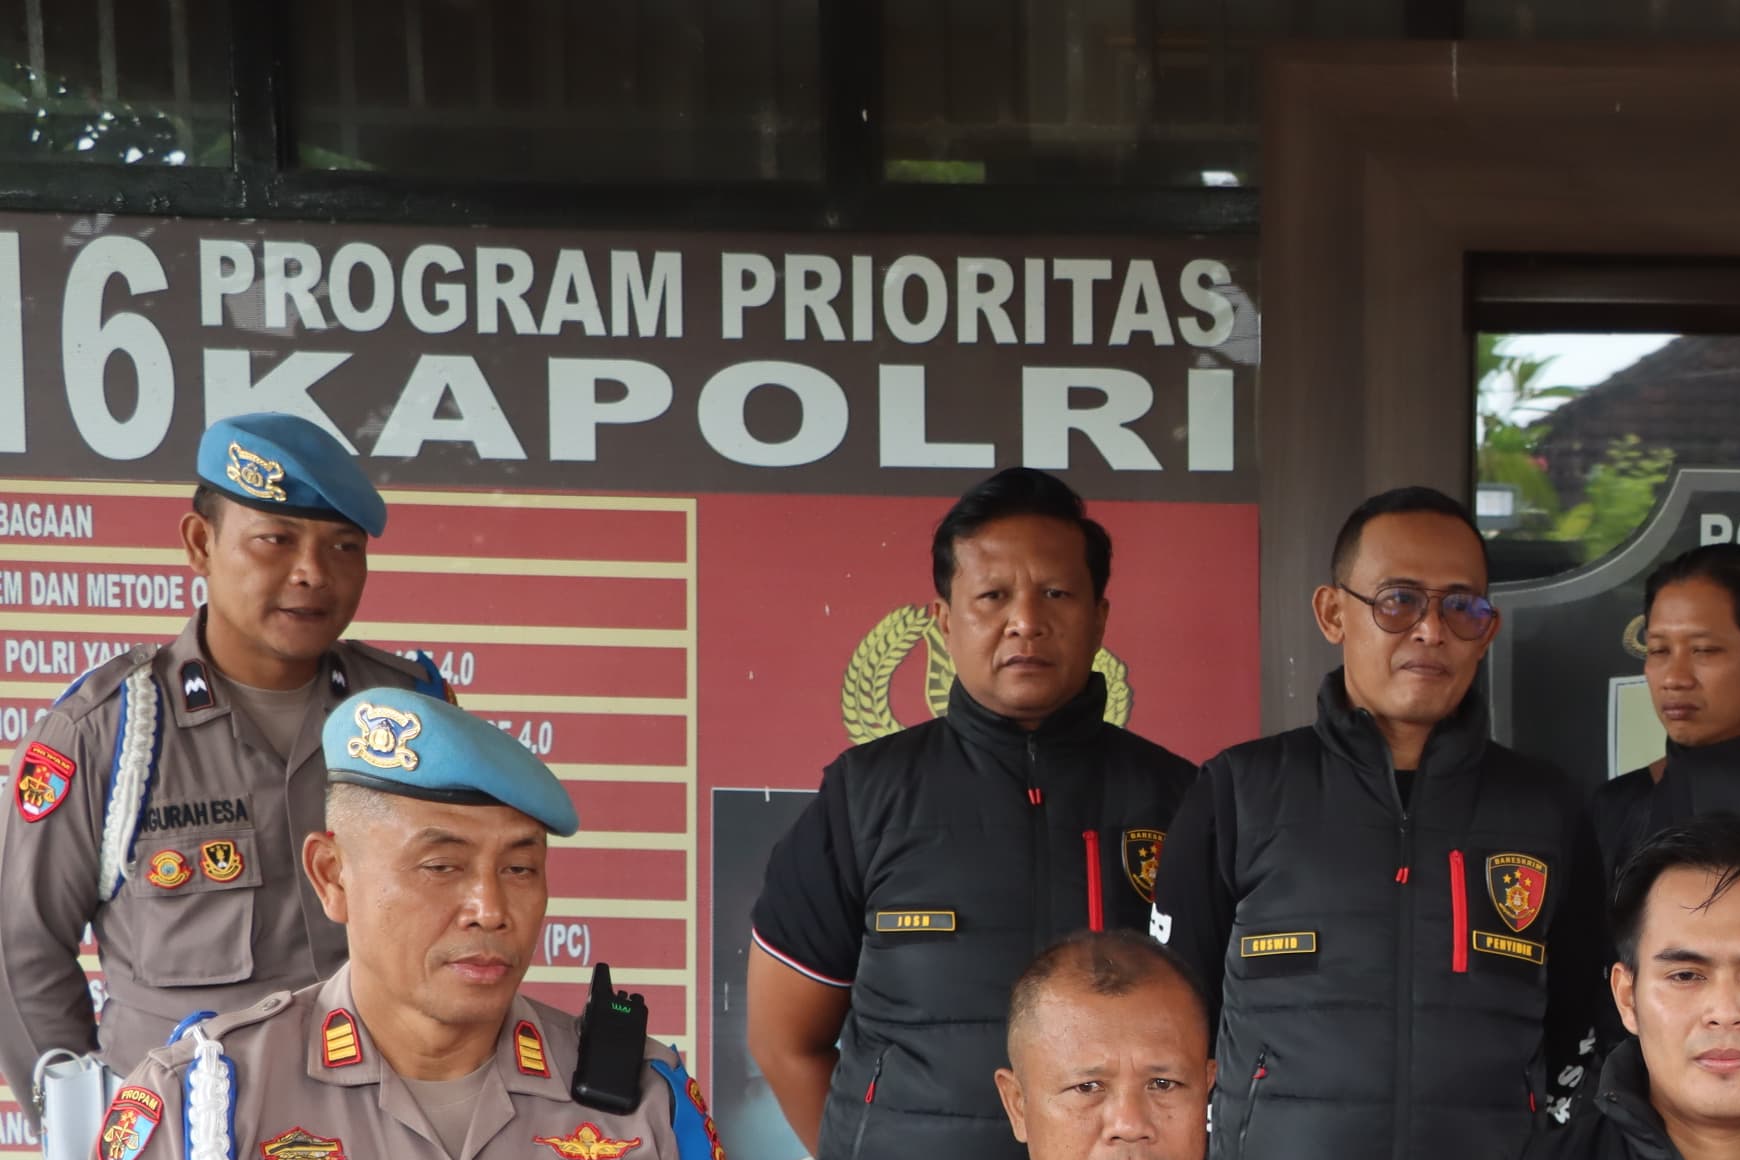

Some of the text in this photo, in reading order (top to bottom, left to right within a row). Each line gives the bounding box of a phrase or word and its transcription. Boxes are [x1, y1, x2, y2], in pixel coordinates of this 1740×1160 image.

[200, 238, 1235, 348] PROGRAM PRIORITAS
[0, 232, 175, 461] 16
[203, 346, 1236, 473] KAPOLRI
[30, 571, 79, 606] DAN
[86, 573, 185, 610] METODE
[5, 639, 76, 675] POLRI
[211, 798, 250, 825] ESA
[544, 922, 592, 966] (PC)
[121, 1089, 159, 1110] PROPAM
